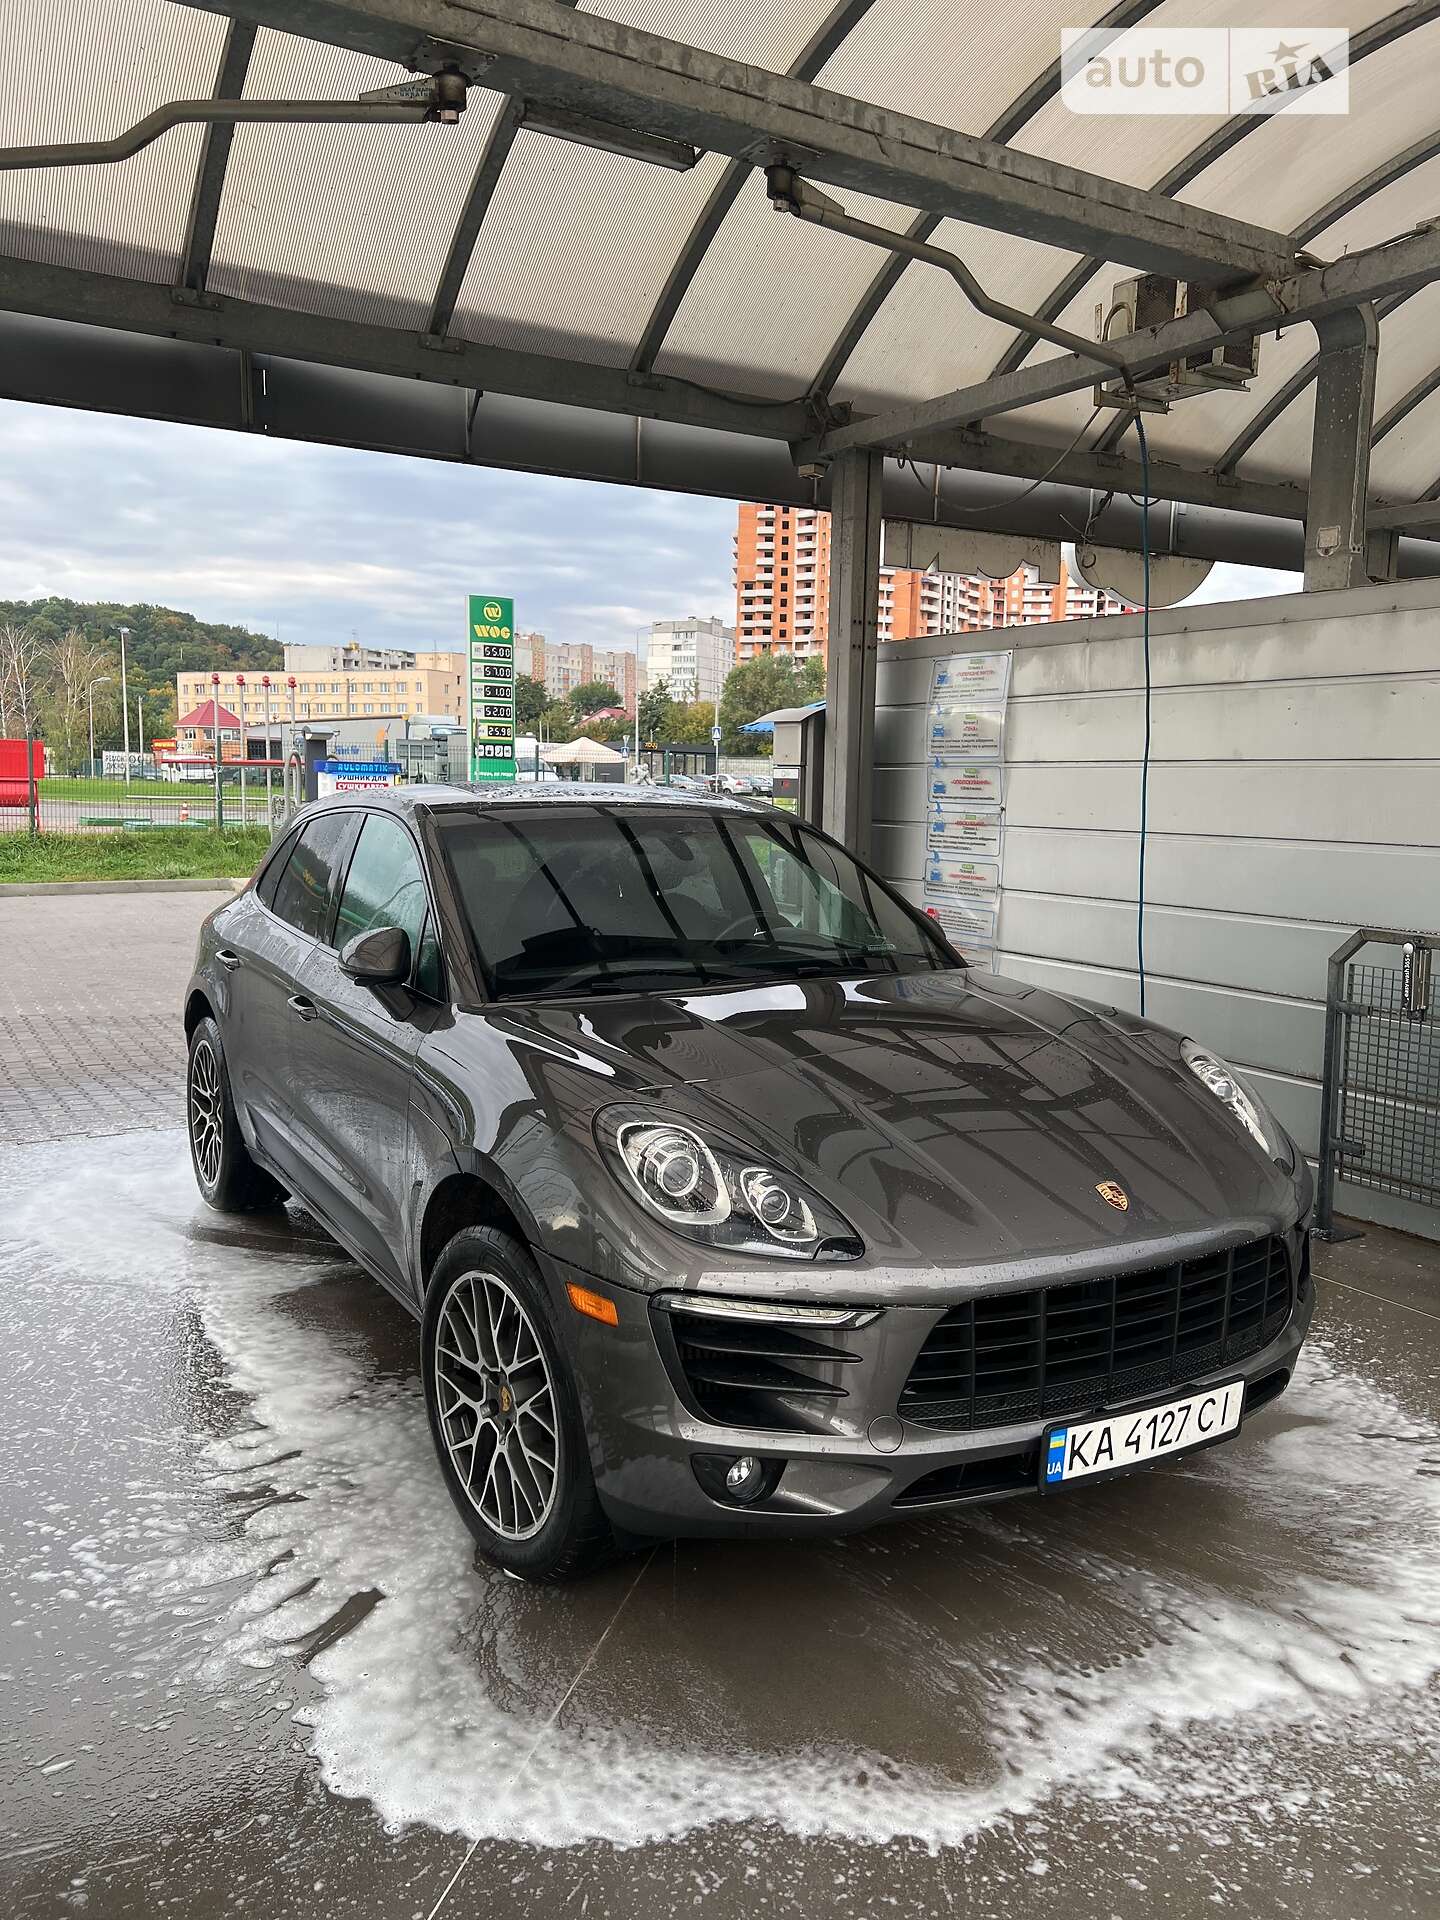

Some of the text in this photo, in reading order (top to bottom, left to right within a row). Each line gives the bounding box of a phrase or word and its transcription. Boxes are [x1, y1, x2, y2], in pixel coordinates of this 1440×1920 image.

[473, 624, 511, 639] WOG
[484, 666, 511, 678] 57.00
[485, 686, 511, 697] 51.00
[485, 706, 511, 717] 52.00
[1068, 1391, 1229, 1471] KA 4127 CI
[1046, 1462, 1062, 1475] UA
